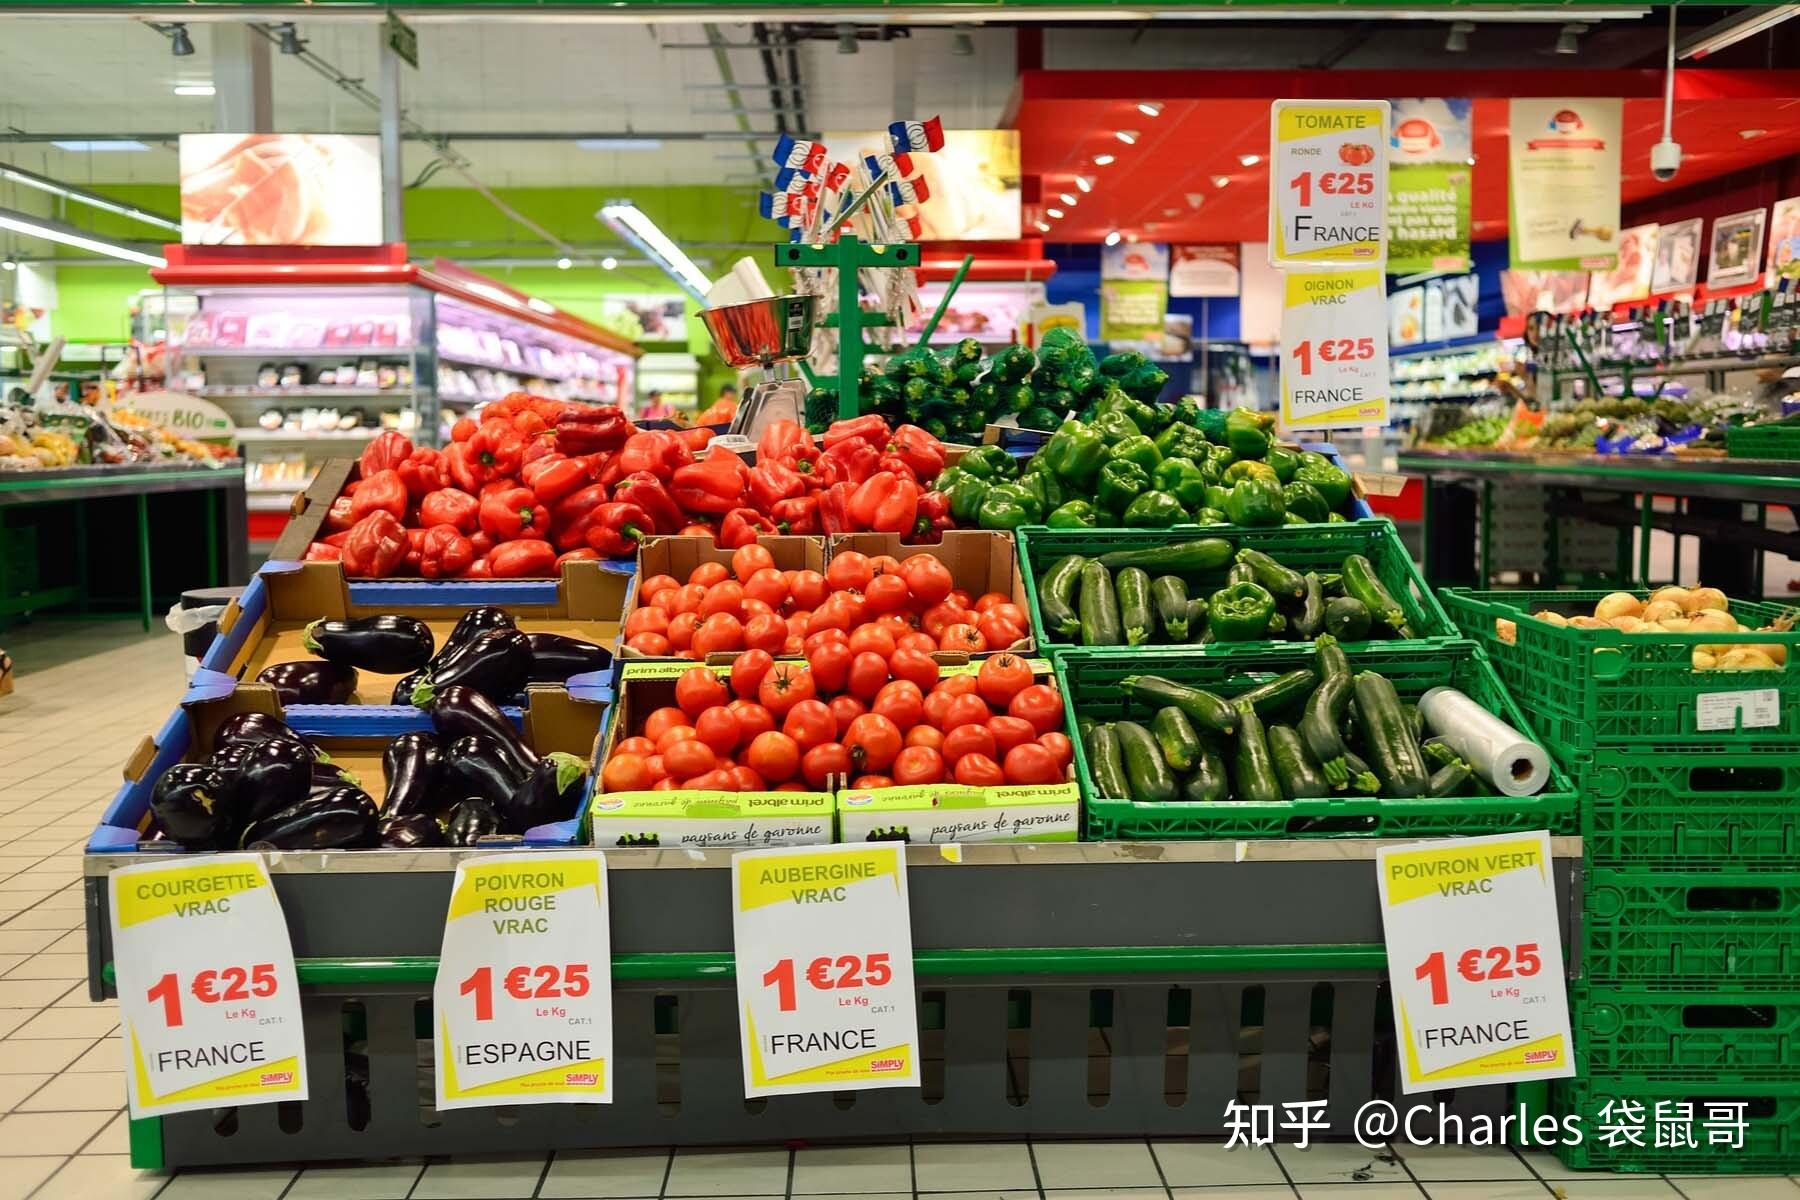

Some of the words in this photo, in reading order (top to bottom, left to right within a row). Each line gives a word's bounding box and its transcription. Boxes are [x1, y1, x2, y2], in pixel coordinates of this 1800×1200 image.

[1296, 115, 1366, 129] TOMATE
[1291, 148, 1321, 156] RONDE
[1290, 171, 1312, 207] 1
[1319, 172, 1374, 195] €25
[1295, 215, 1380, 242] FRANCE
[1304, 279, 1354, 291] OIGNON
[1311, 294, 1347, 306] VRAC
[1293, 340, 1312, 376] 1
[1318, 337, 1375, 362] €25
[1295, 387, 1364, 404] FRANCE
[172, 409, 205, 429] BIO
[681, 829, 737, 847] paysans
[743, 823, 758, 845] de
[763, 824, 822, 843] garonne
[930, 821, 988, 842] paysans
[993, 812, 1008, 832] de
[1013, 812, 1072, 832] garonne
[759, 862, 876, 885] AUBERGINE
[1391, 856, 1480, 881] POIVRON
[1485, 852, 1536, 870] VERT
[136, 873, 257, 900] COURGETTE
[475, 872, 564, 892] POIVRON
[1438, 878, 1493, 898] VRAC
[485, 895, 556, 913] ROUGE
[791, 886, 847, 905] VRAC
[174, 898, 231, 918] VRAC
[492, 918, 548, 935] VRAC
[763, 958, 797, 1012] 1
[805, 953, 892, 990] €25
[1415, 951, 1449, 1006] 1
[1457, 943, 1542, 983] €25
[147, 973, 184, 1028] 1
[191, 963, 278, 1003] €25
[460, 966, 493, 1021] 1
[504, 964, 590, 1000] €25
[838, 997, 851, 1006] Le
[854, 996, 869, 1007] Kg
[1490, 988, 1504, 998] Le
[1505, 987, 1520, 998] Kg
[225, 1010, 239, 1019] Le
[241, 1008, 256, 1020] Kg
[536, 1007, 549, 1017] Le
[551, 1007, 566, 1018] Kg
[771, 1028, 877, 1055] FRANCE
[1425, 1019, 1530, 1049] FRANCE
[158, 1040, 265, 1072] FRANCE
[466, 1040, 591, 1065] ESPAGNE
